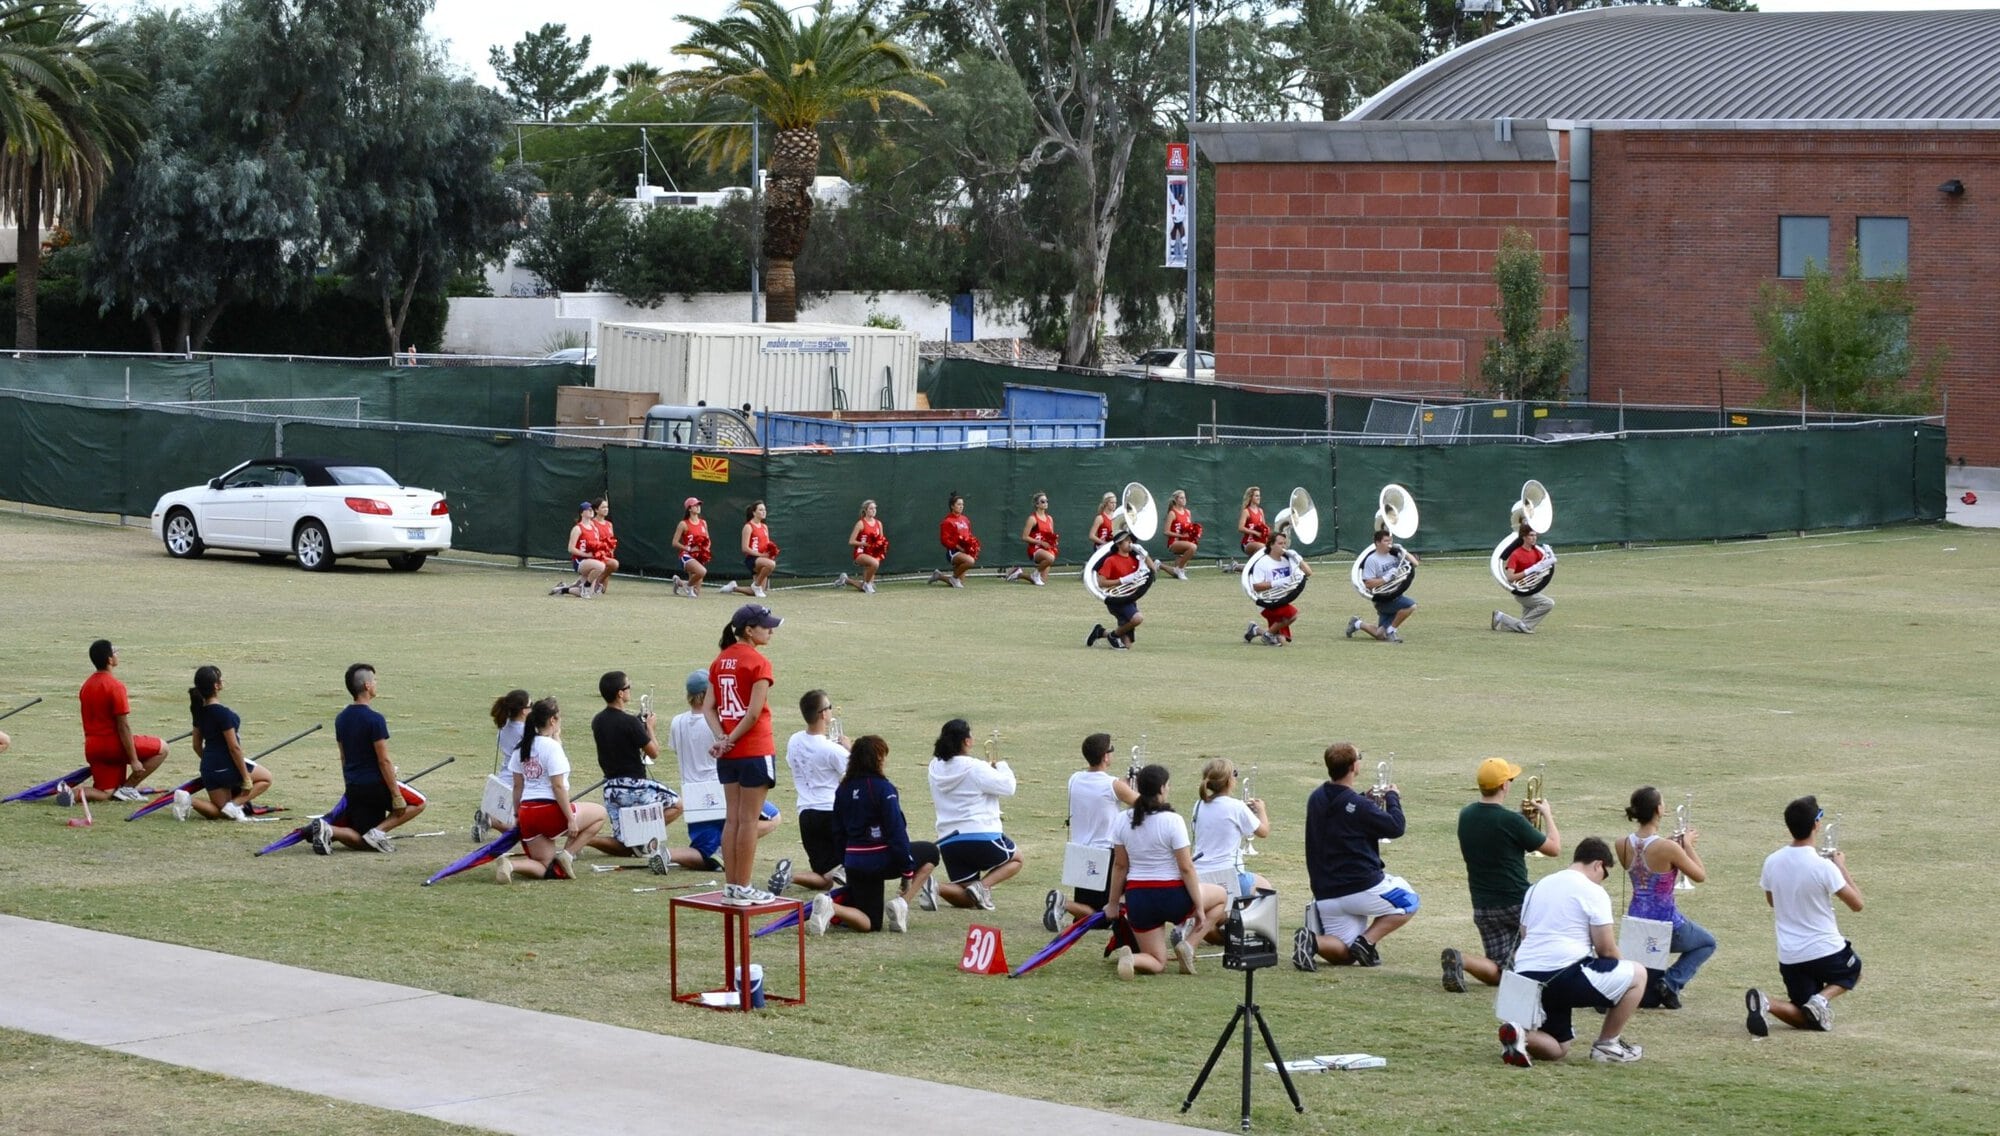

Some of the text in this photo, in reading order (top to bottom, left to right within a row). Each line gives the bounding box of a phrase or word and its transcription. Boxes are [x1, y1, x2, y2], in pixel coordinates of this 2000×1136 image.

[1169, 148, 1185, 167] A
[719, 675, 748, 720] A
[963, 929, 995, 970] 30
